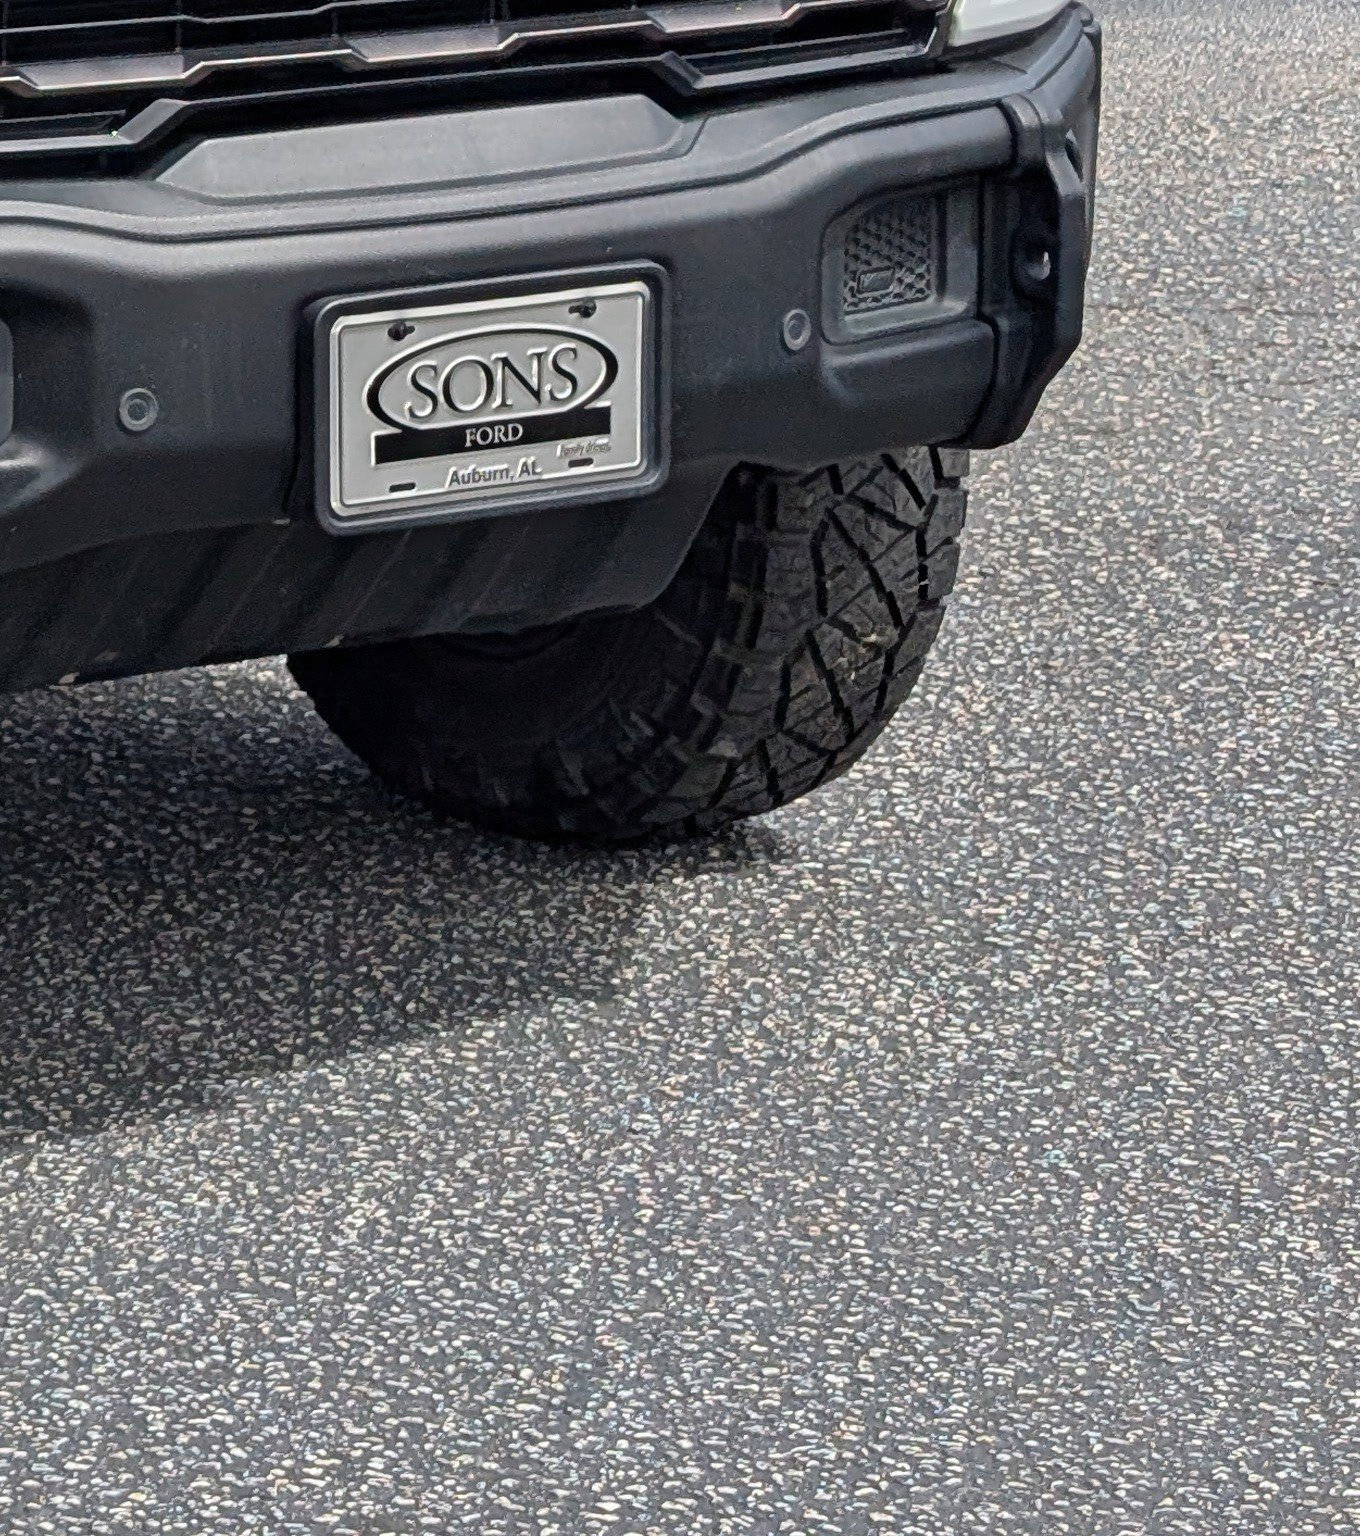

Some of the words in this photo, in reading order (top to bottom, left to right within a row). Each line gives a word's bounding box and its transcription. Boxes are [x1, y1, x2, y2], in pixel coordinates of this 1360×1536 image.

[404, 342, 579, 420] SONS
[464, 422, 524, 448] FORD
[446, 465, 515, 488] Auburn,
[517, 456, 543, 479] AL
